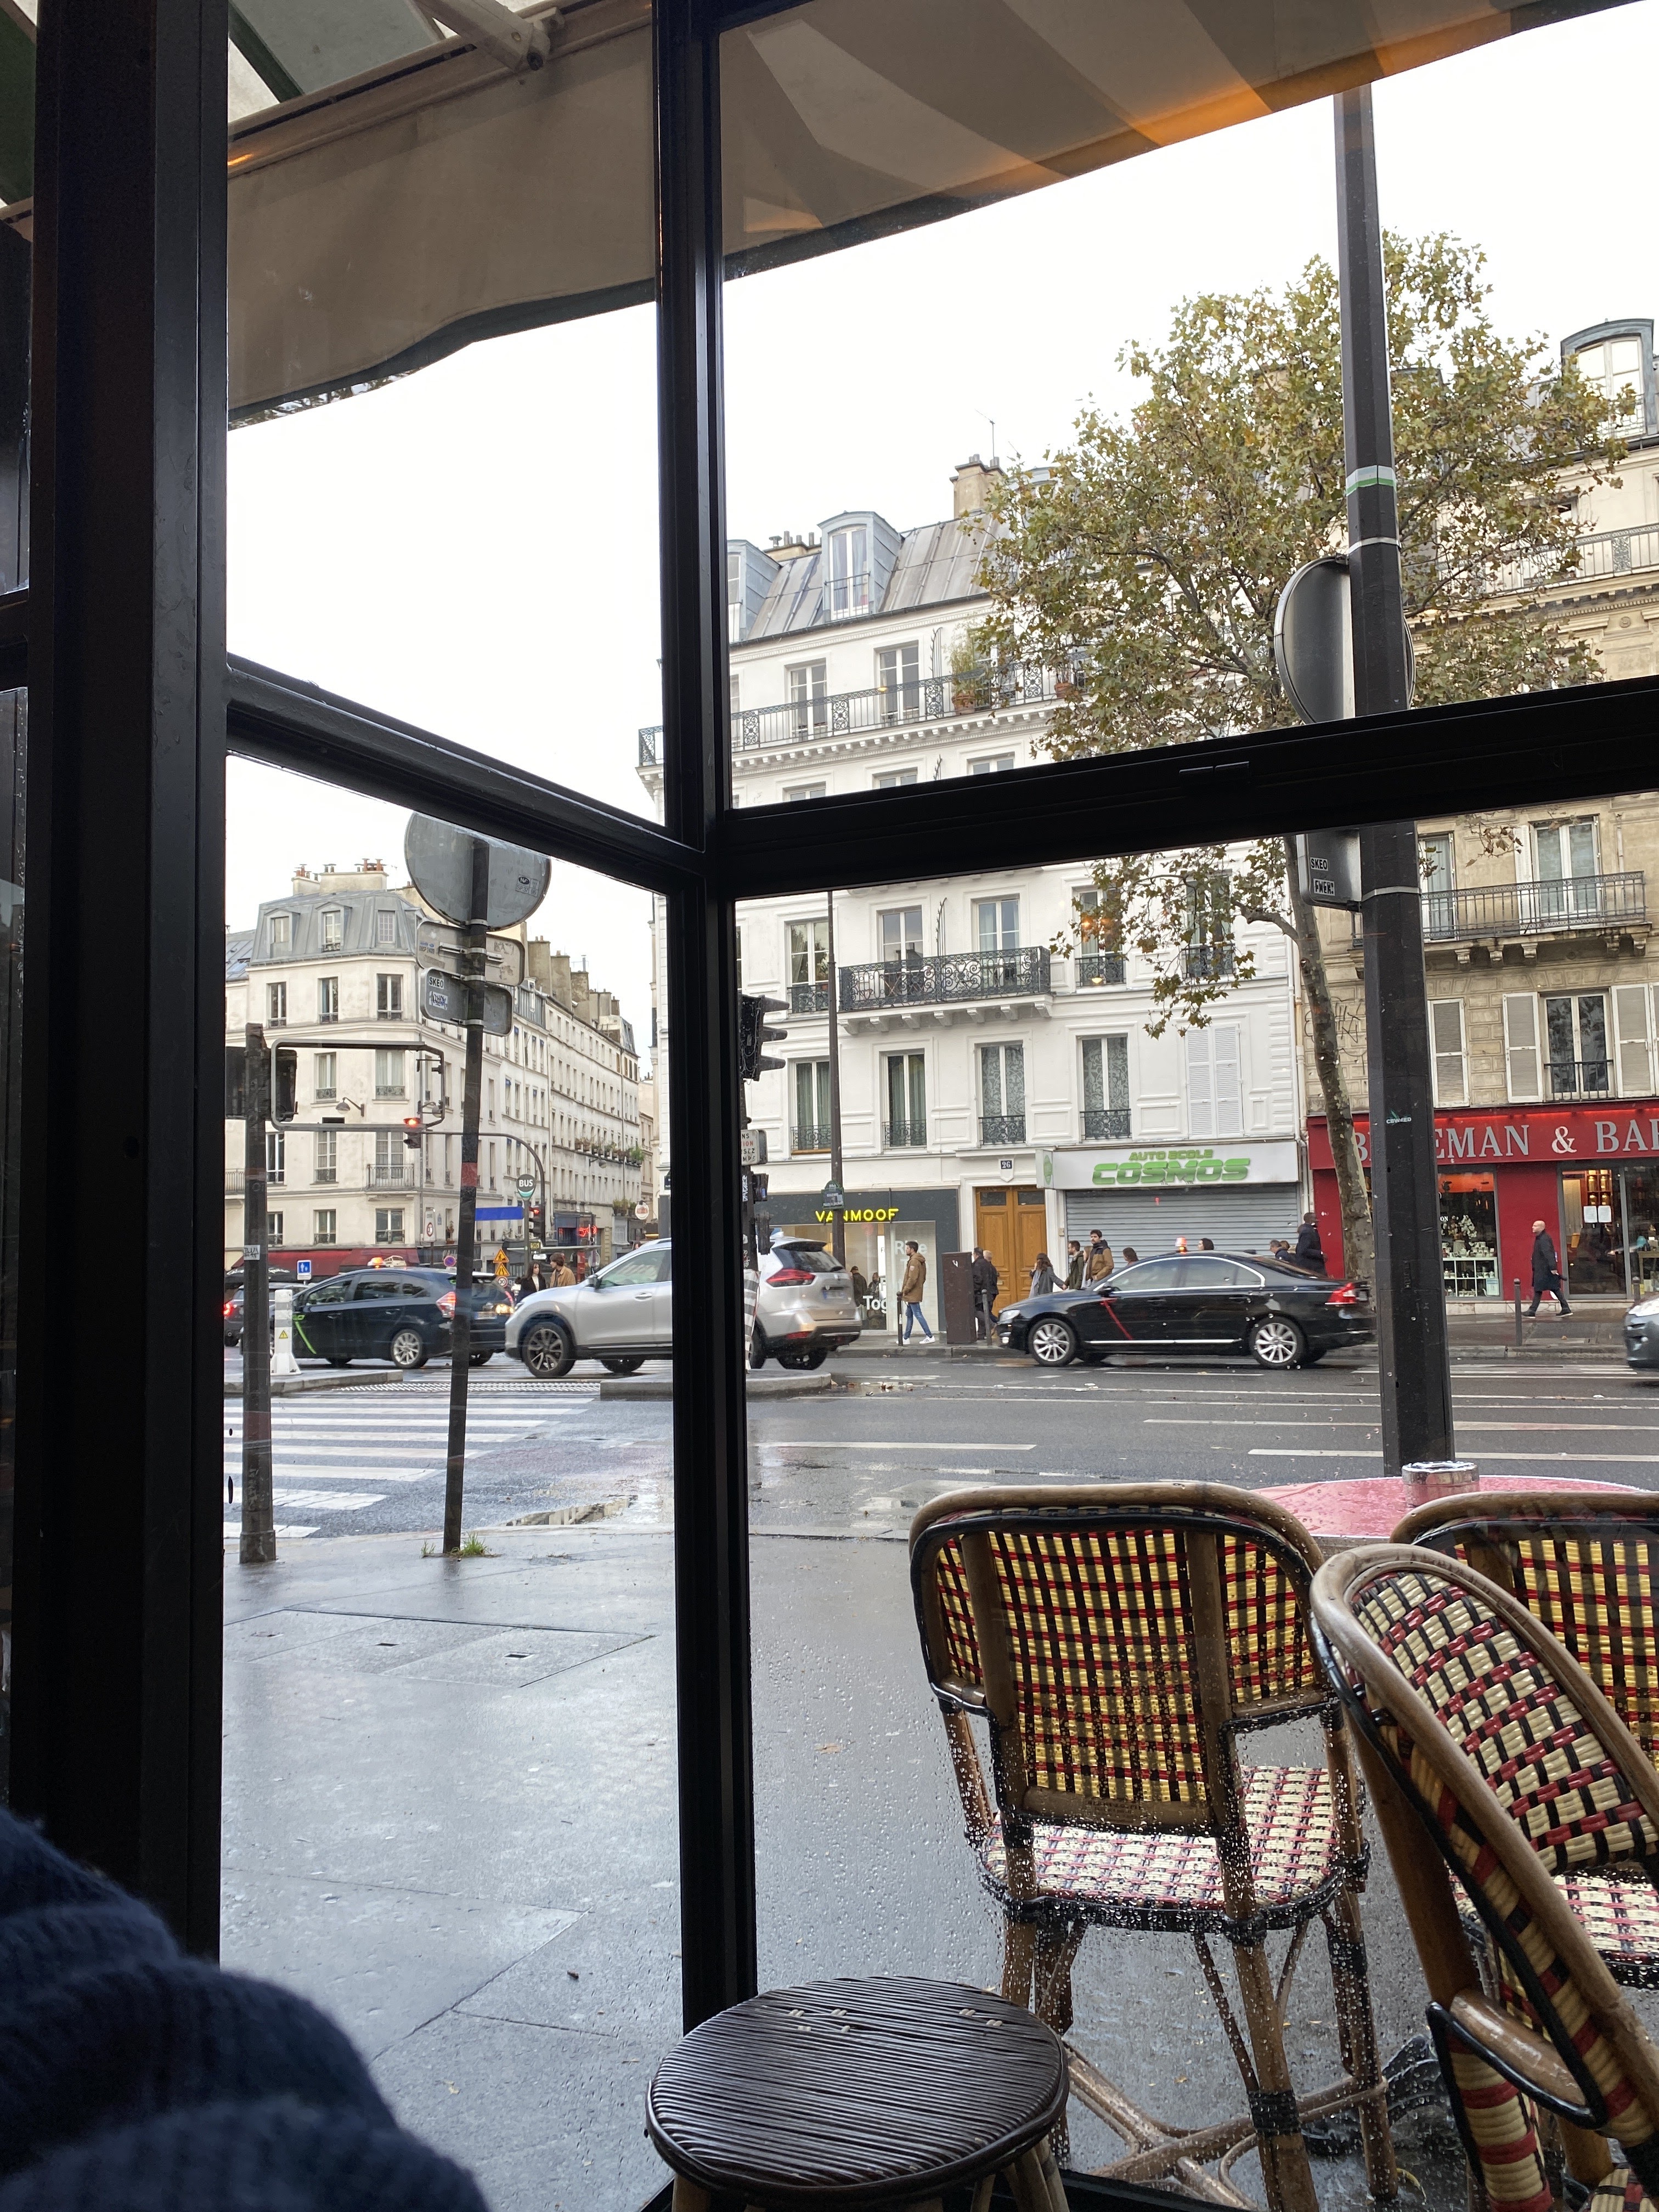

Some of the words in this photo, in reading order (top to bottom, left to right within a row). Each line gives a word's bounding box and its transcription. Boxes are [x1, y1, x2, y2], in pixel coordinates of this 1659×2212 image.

[1311, 859, 1328, 870] SKEO
[429, 977, 444, 988] SKEO
[1551, 1126, 1577, 1154] &
[1129, 1152, 1166, 1161] AUTO
[1168, 1149, 1213, 1160] ECOLE
[1092, 1158, 1250, 1185] COSMOS
[519, 1179, 533, 1187] BUS
[894, 1239, 928, 1255] Re
[862, 1295, 887, 1314] Tog
